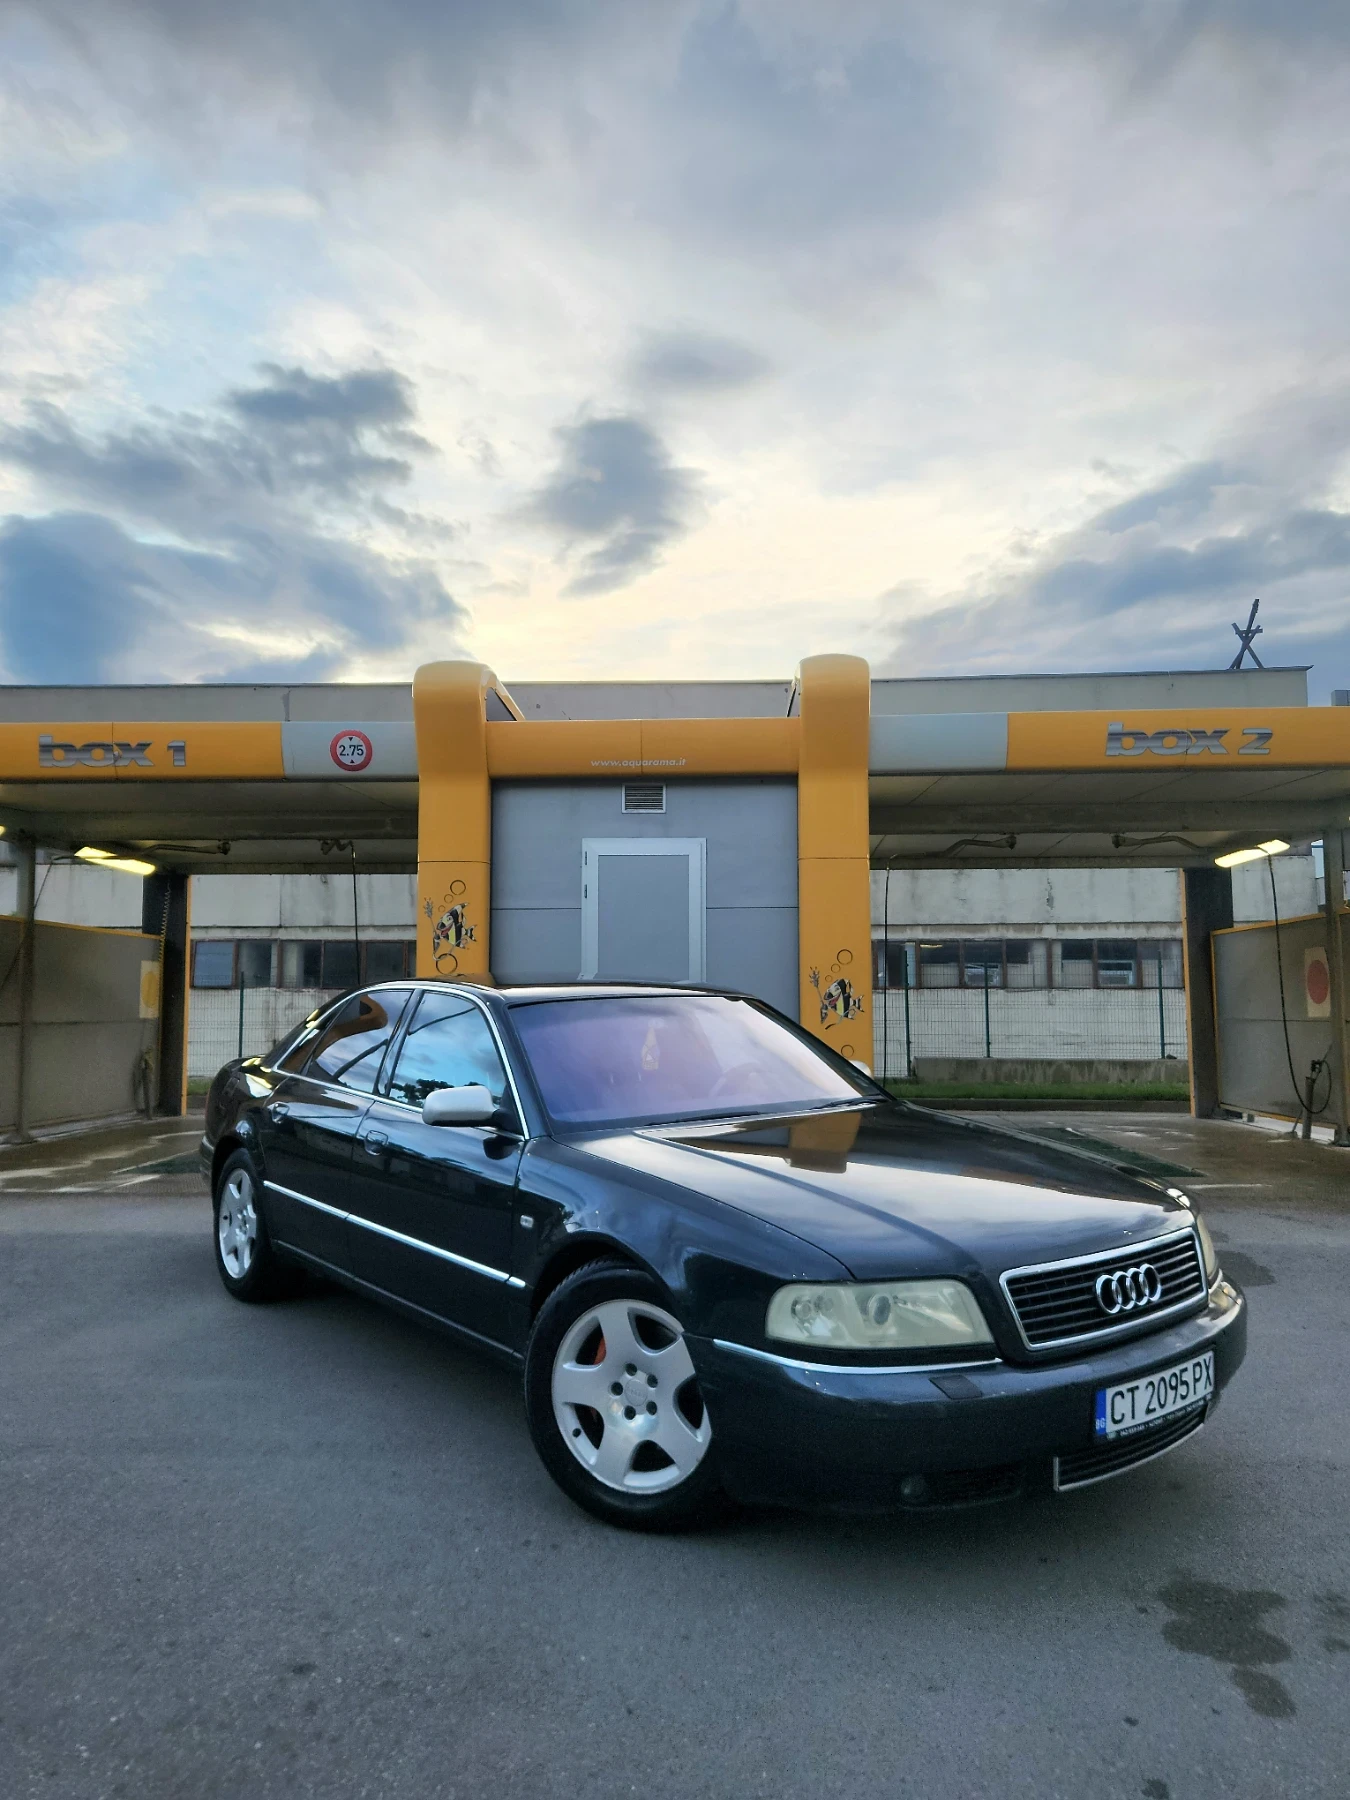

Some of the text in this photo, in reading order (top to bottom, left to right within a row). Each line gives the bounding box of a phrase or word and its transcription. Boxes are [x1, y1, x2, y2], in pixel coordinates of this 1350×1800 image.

[339, 744, 364, 756] 2.75
[1105, 722, 1273, 756] box 2
[39, 734, 187, 768] box 1
[590, 757, 686, 769] www.aquarama.it
